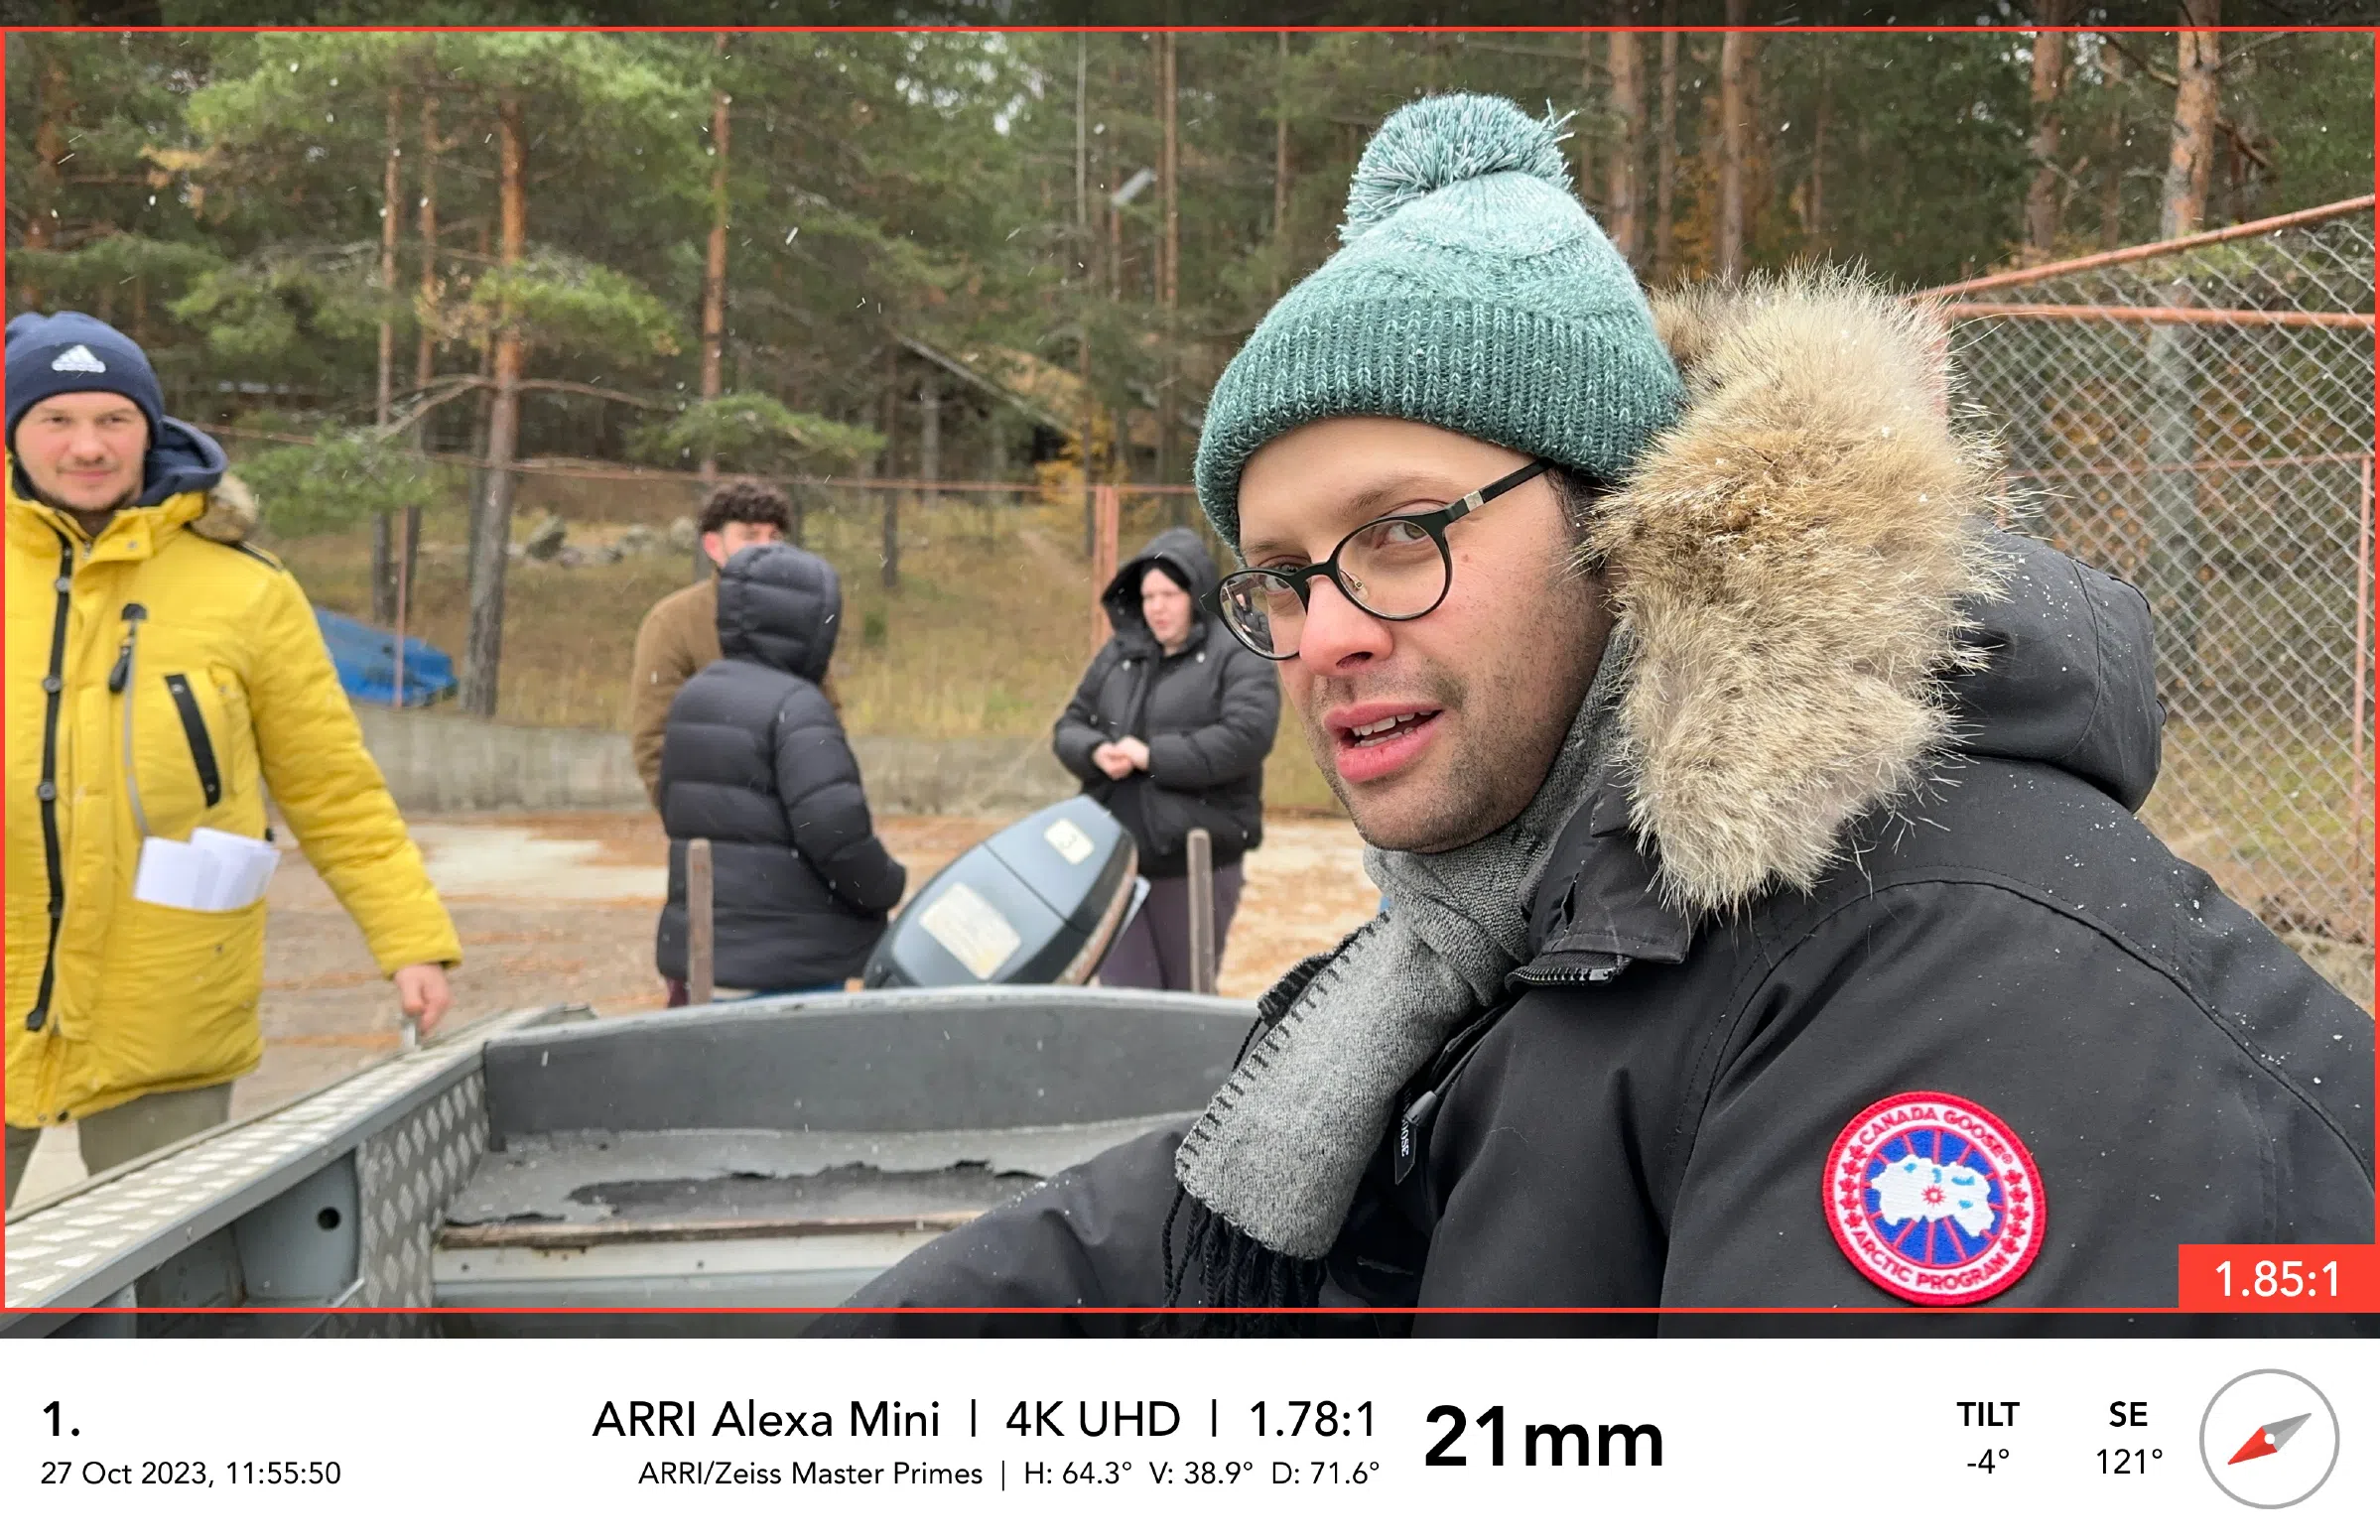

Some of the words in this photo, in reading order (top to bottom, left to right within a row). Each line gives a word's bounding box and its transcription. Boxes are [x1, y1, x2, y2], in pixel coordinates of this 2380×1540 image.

[1400, 1118, 1409, 1158] OOSE
[1859, 1106, 1938, 1146] CANADA
[1851, 1230, 1914, 1283] ARCTIC
[1916, 1251, 2013, 1291] PROGRAM
